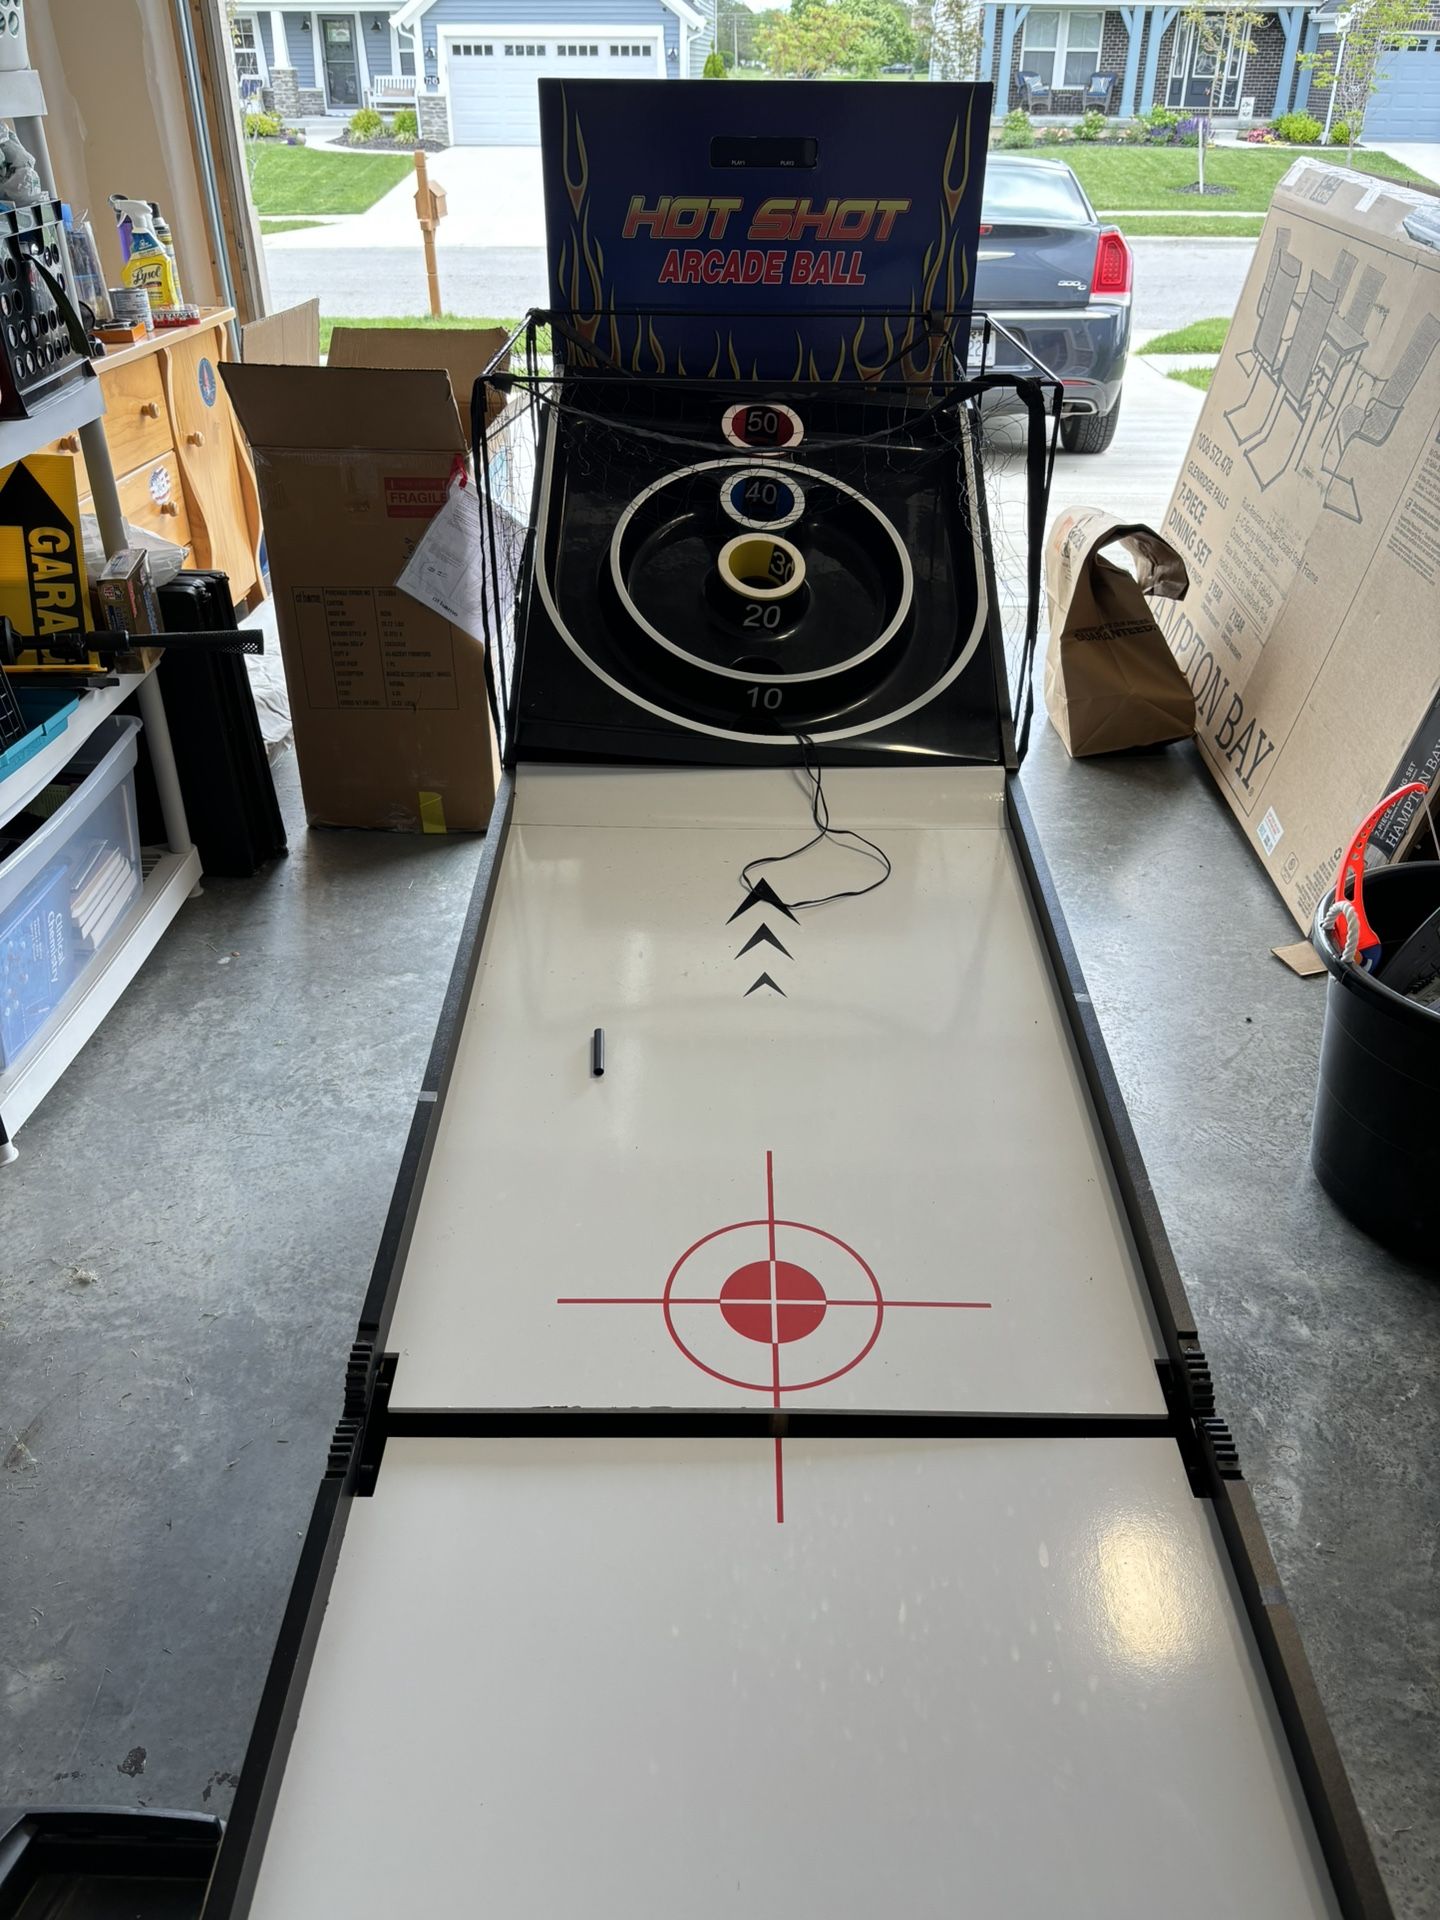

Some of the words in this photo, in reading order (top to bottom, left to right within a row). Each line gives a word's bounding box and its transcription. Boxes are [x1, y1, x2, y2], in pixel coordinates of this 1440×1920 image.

[622, 196, 744, 240] HOT
[748, 198, 912, 241] SHOT
[131, 263, 160, 285] Lysol
[658, 250, 787, 285] ARCADE
[790, 251, 866, 285] BALL
[747, 411, 779, 434] 50
[746, 481, 779, 505] 40
[1177, 481, 1208, 526] 7-PIECE
[1212, 487, 1229, 510] FALLS
[1168, 507, 1197, 551] DINING
[1194, 538, 1212, 568] SET
[1302, 561, 1319, 585] Frame
[28, 527, 79, 660] GARA
[743, 603, 781, 629] 20
[746, 686, 782, 709] 10
[1150, 598, 1230, 727] AMPTON
[1214, 692, 1275, 790] BAY
[1374, 808, 1392, 837] 7-PIECE
[1406, 761, 1416, 777] SET
[47, 910, 59, 983] Chemistry
[55, 912, 66, 966] Clinical
